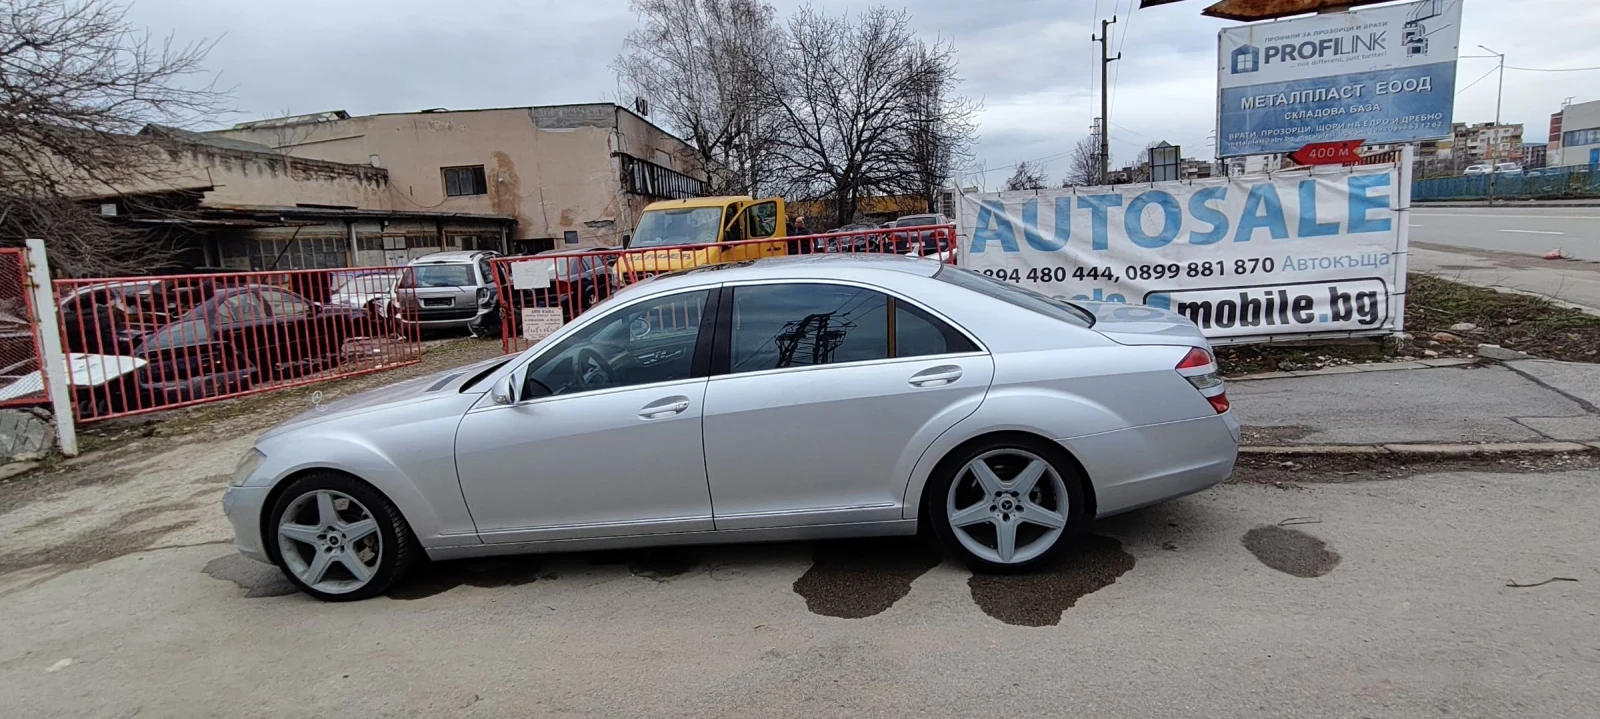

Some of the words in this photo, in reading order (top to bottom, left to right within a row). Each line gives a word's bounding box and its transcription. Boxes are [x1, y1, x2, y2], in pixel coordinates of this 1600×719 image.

[1363, 21, 1389, 30] ВРАТИ
[1264, 30, 1387, 65] PROFILINK
[1346, 55, 1360, 63] just
[1241, 83, 1366, 110] МЕТАЛПЛАСТ
[1375, 76, 1432, 96] ЕООД
[1284, 106, 1346, 120] СКЛАДОВА
[1350, 103, 1381, 114] БАЗА
[1316, 123, 1345, 132] ЩОРИ
[1348, 121, 1360, 129] НА
[1363, 118, 1390, 127] ЕДРО
[1392, 117, 1399, 125] И
[1401, 112, 1443, 124] ДРЕБНО
[1309, 146, 1335, 159] 400
[969, 172, 1393, 254] AUTOSALE
[973, 268, 1021, 284] 894
[1026, 266, 1066, 283] 480
[1072, 266, 1120, 283] 444,
[1125, 263, 1181, 280] 0899
[1186, 261, 1225, 278] 881
[1233, 257, 1275, 275] 870
[1281, 252, 1390, 272] Автокъща
[1177, 286, 1378, 330] mobile.bg
